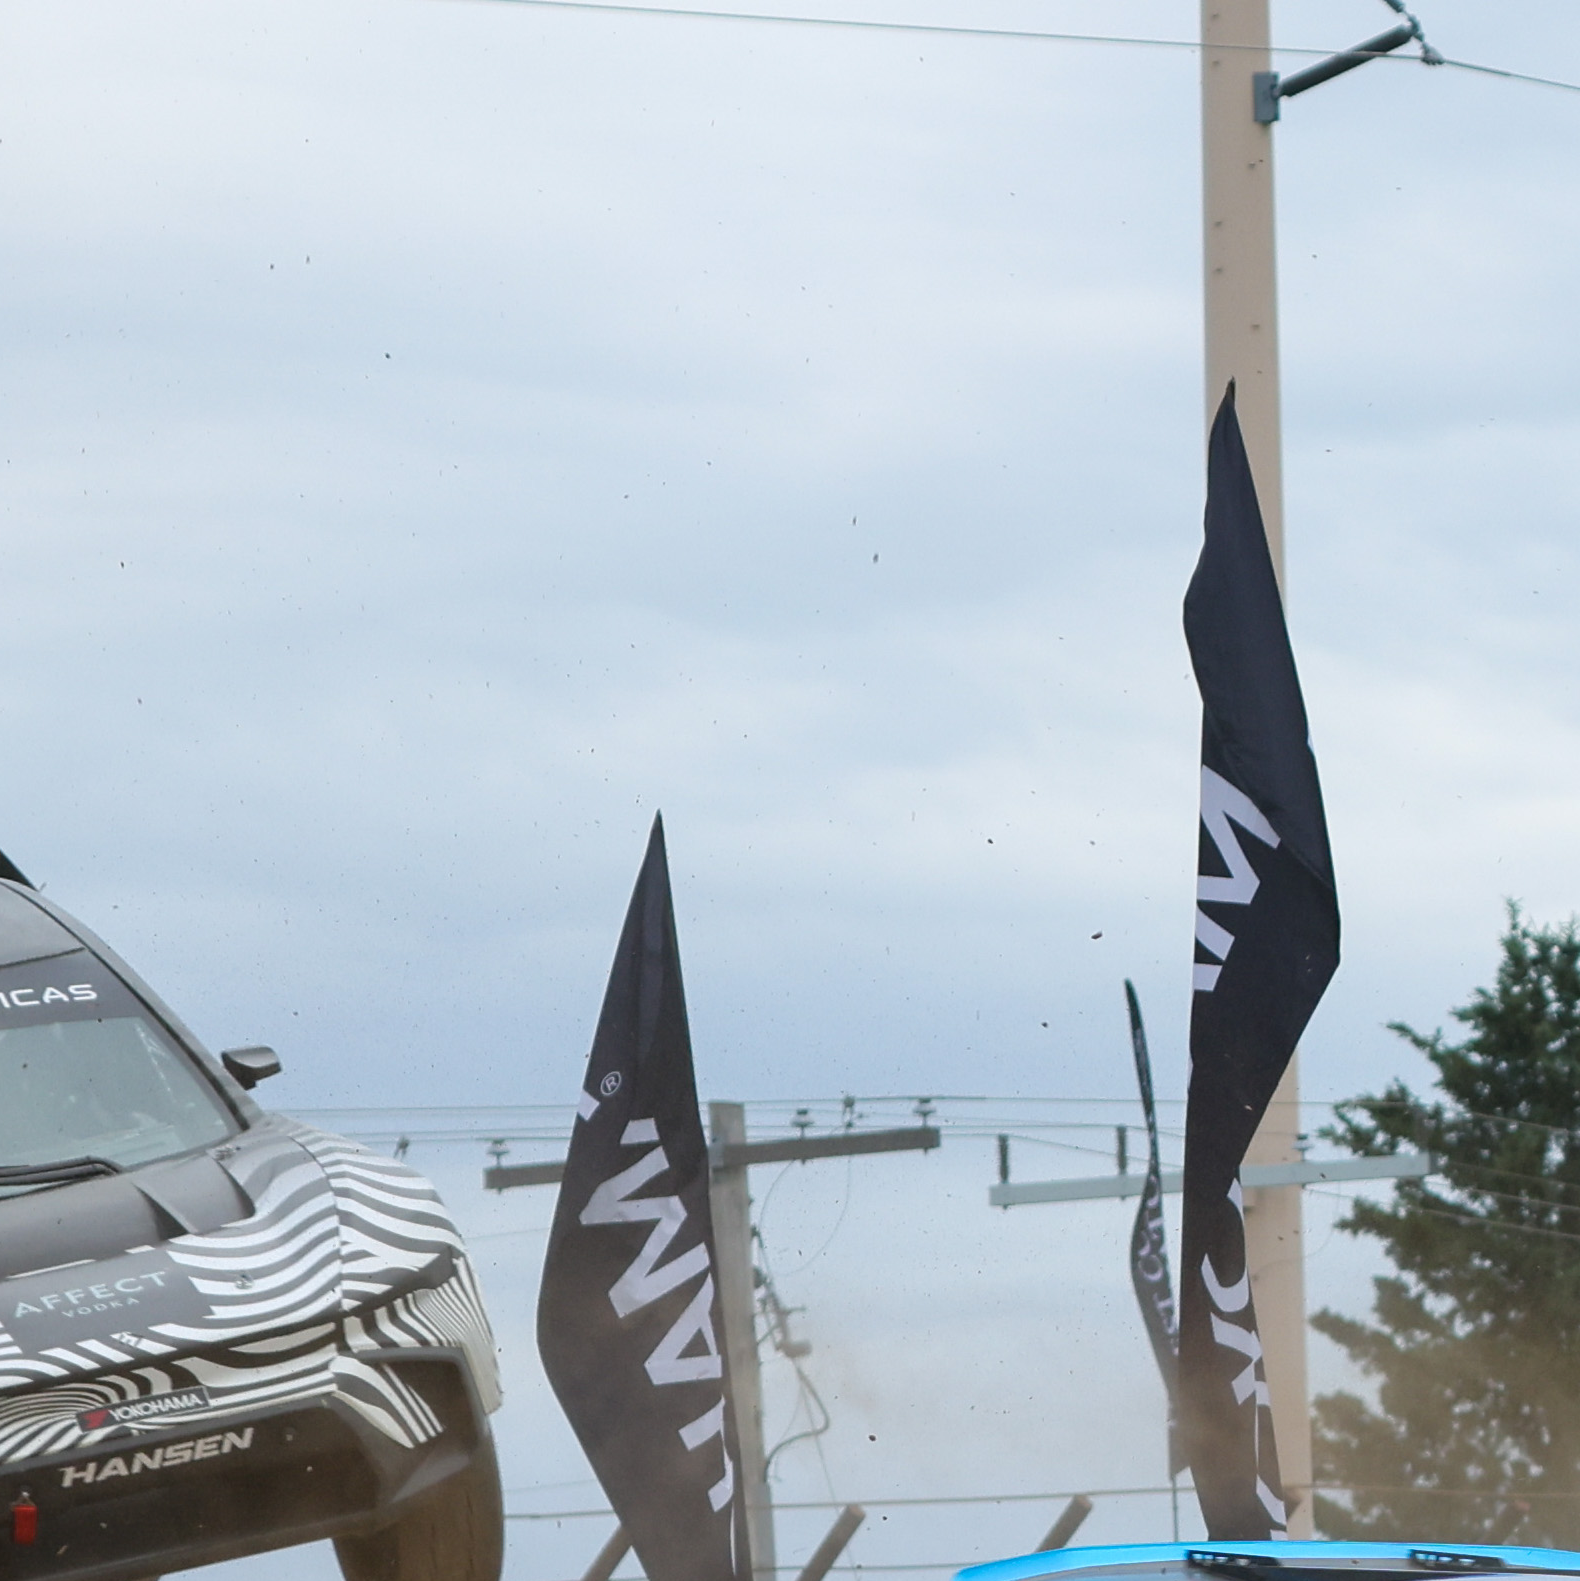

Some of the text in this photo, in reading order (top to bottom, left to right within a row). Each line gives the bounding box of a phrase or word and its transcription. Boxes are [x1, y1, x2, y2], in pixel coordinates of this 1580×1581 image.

[15, 1271, 167, 1318] AFFECT
[60, 1297, 141, 1318] VODKA
[108, 1393, 203, 1420] YOKOHAMA
[59, 1427, 255, 1489] HANSEN
